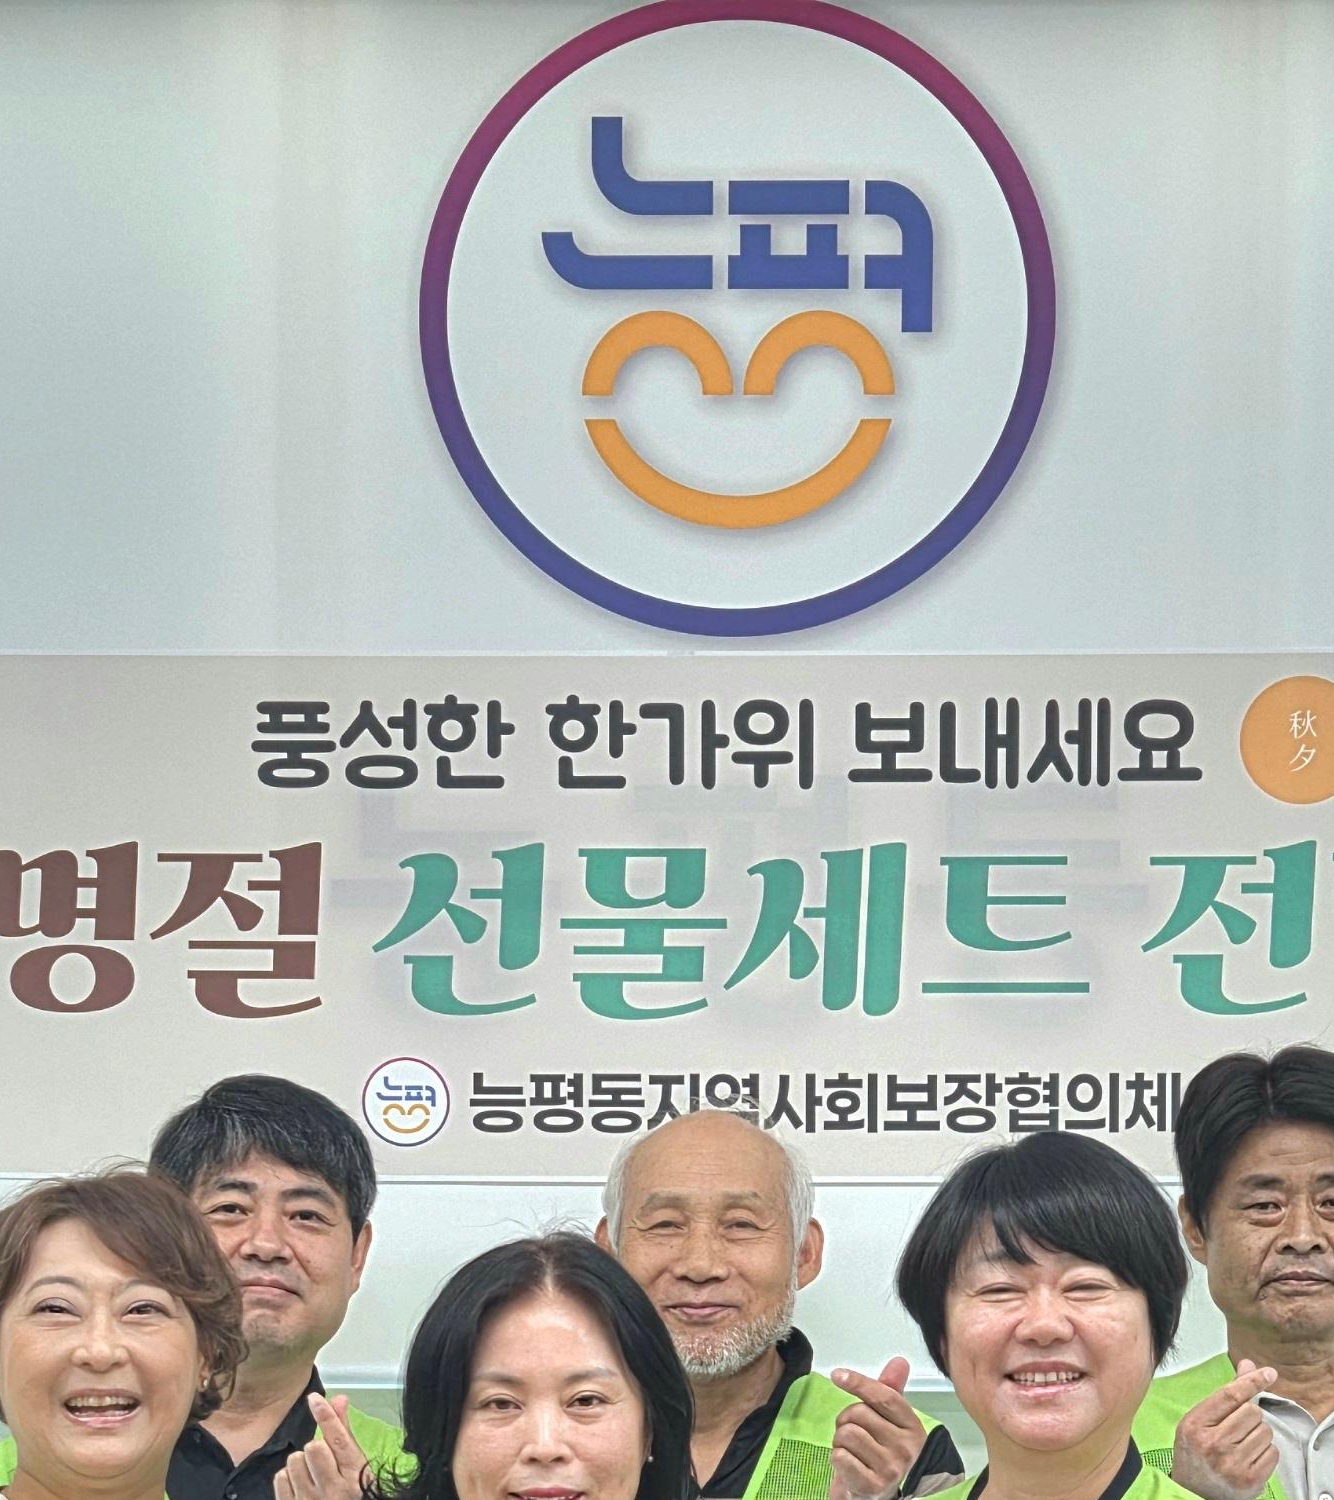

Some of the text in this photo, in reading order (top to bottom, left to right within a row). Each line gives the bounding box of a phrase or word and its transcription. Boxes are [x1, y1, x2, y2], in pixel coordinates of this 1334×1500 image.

[251, 694, 1203, 790] 풍성한 한가위 보내세요
[1289, 709, 1318, 773] 秋夕
[372, 838, 1089, 1020] 선물세트
[469, 1072, 1181, 1134] 능평동지역사회보장협의체
